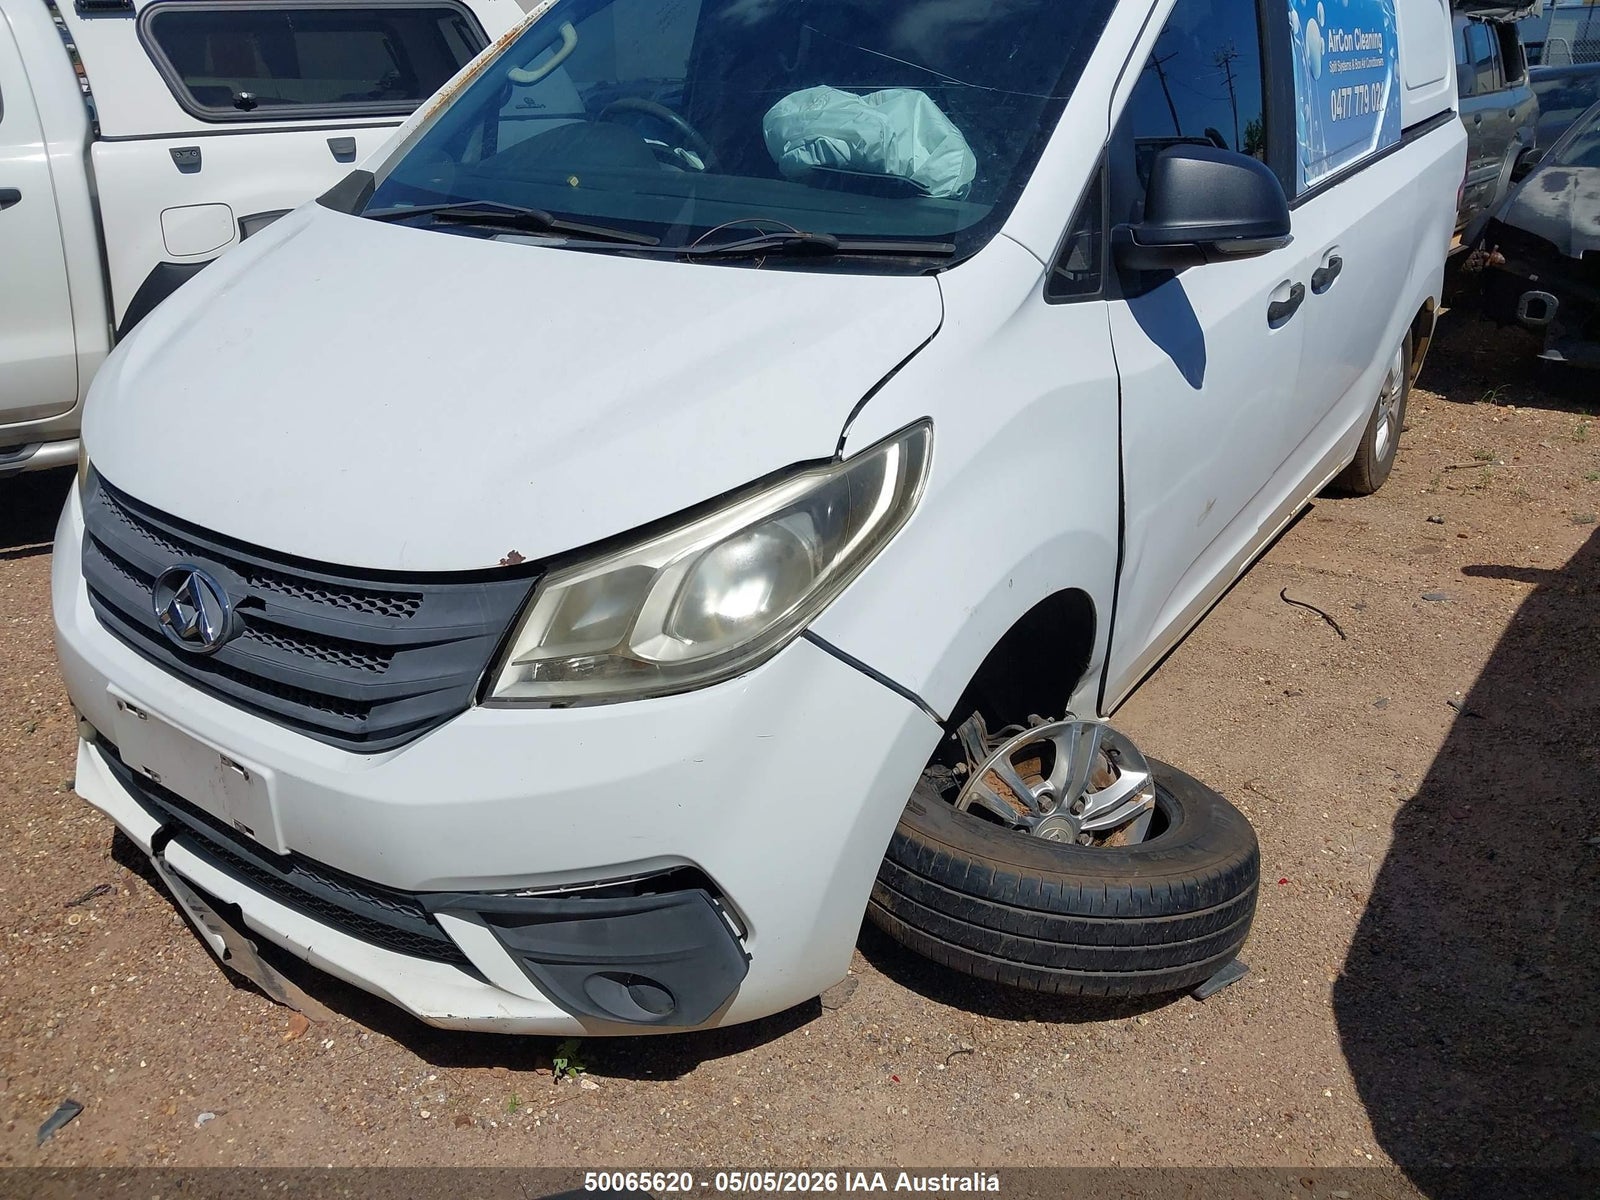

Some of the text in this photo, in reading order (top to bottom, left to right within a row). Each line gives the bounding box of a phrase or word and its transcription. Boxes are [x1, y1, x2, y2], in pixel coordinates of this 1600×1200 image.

[1328, 27, 1383, 54] AirCon Cleaning
[1331, 86, 1352, 122] 0477
[1354, 83, 1369, 115] 779
